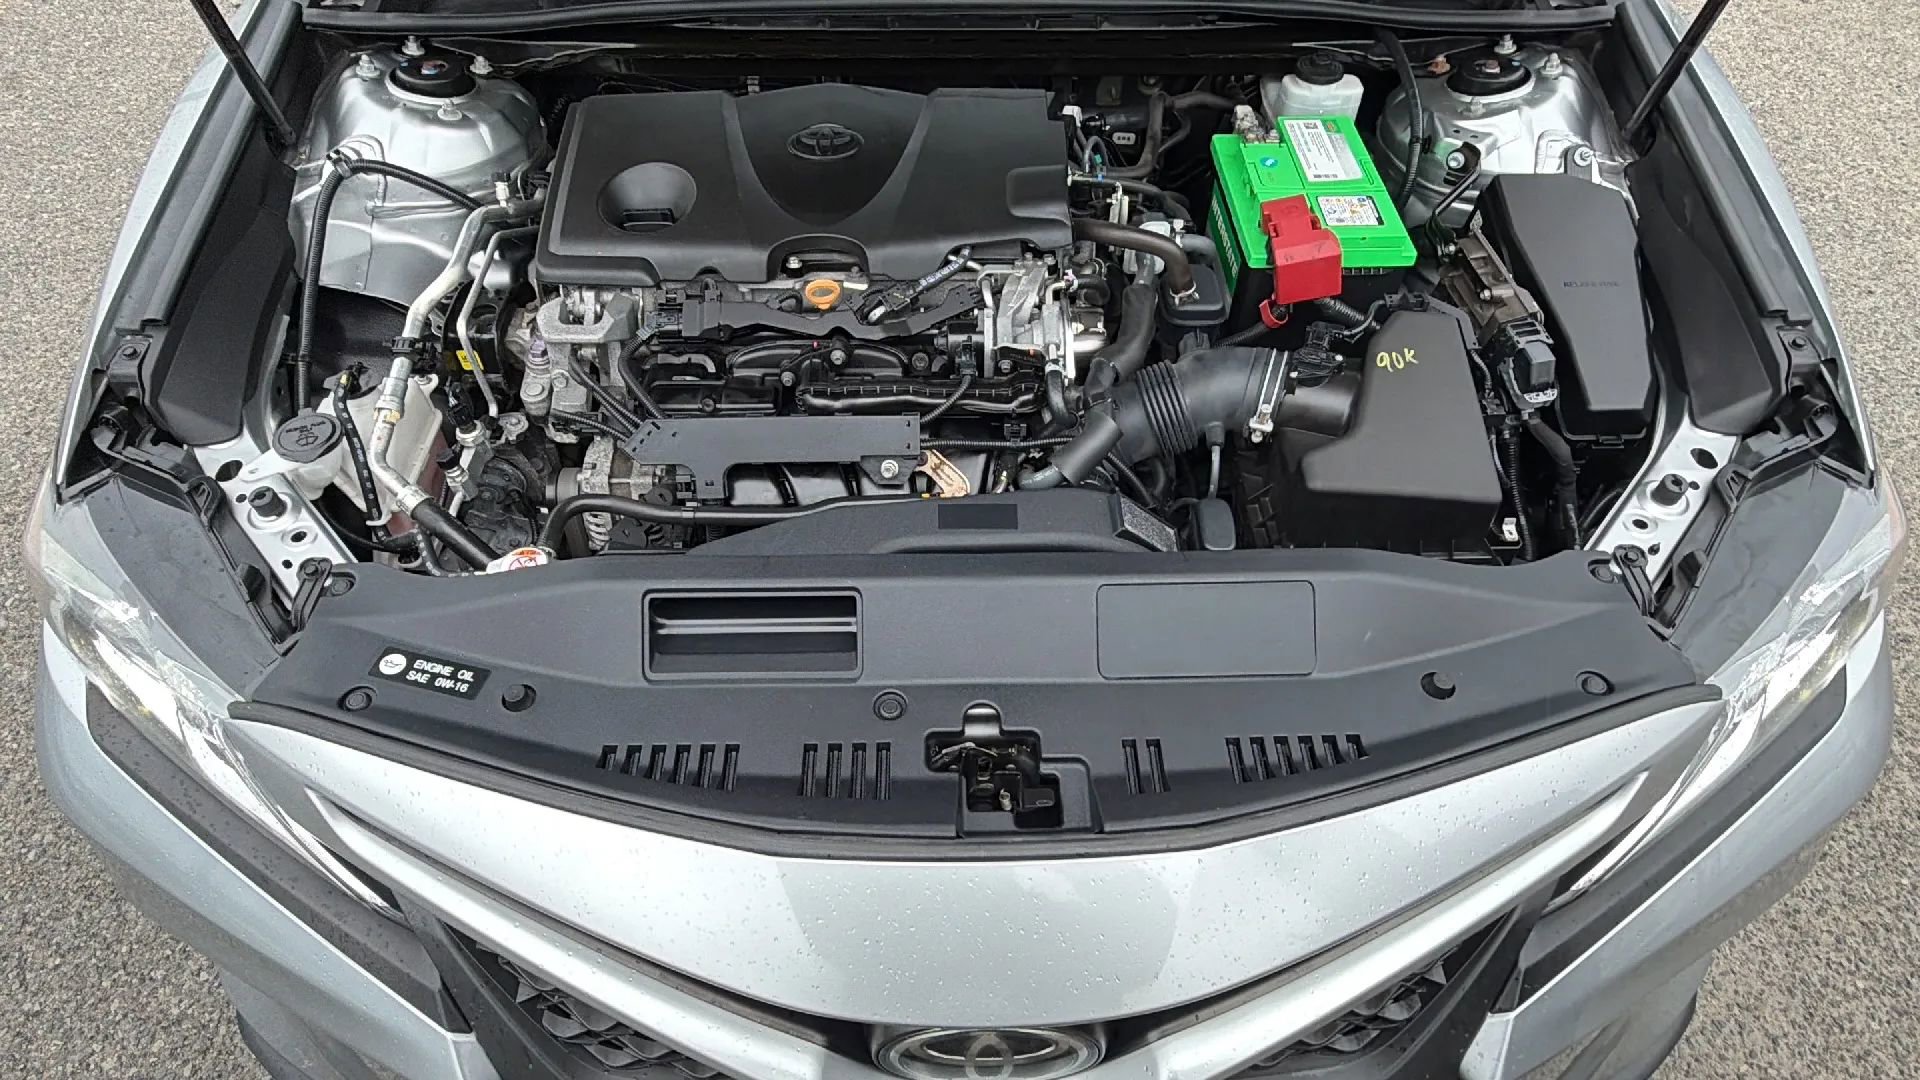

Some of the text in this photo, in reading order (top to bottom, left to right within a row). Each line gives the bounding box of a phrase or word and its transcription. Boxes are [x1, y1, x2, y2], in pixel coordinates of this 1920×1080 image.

[405, 670, 469, 693] SAE 0W-16
[413, 659, 475, 682] ENGINE OIL
